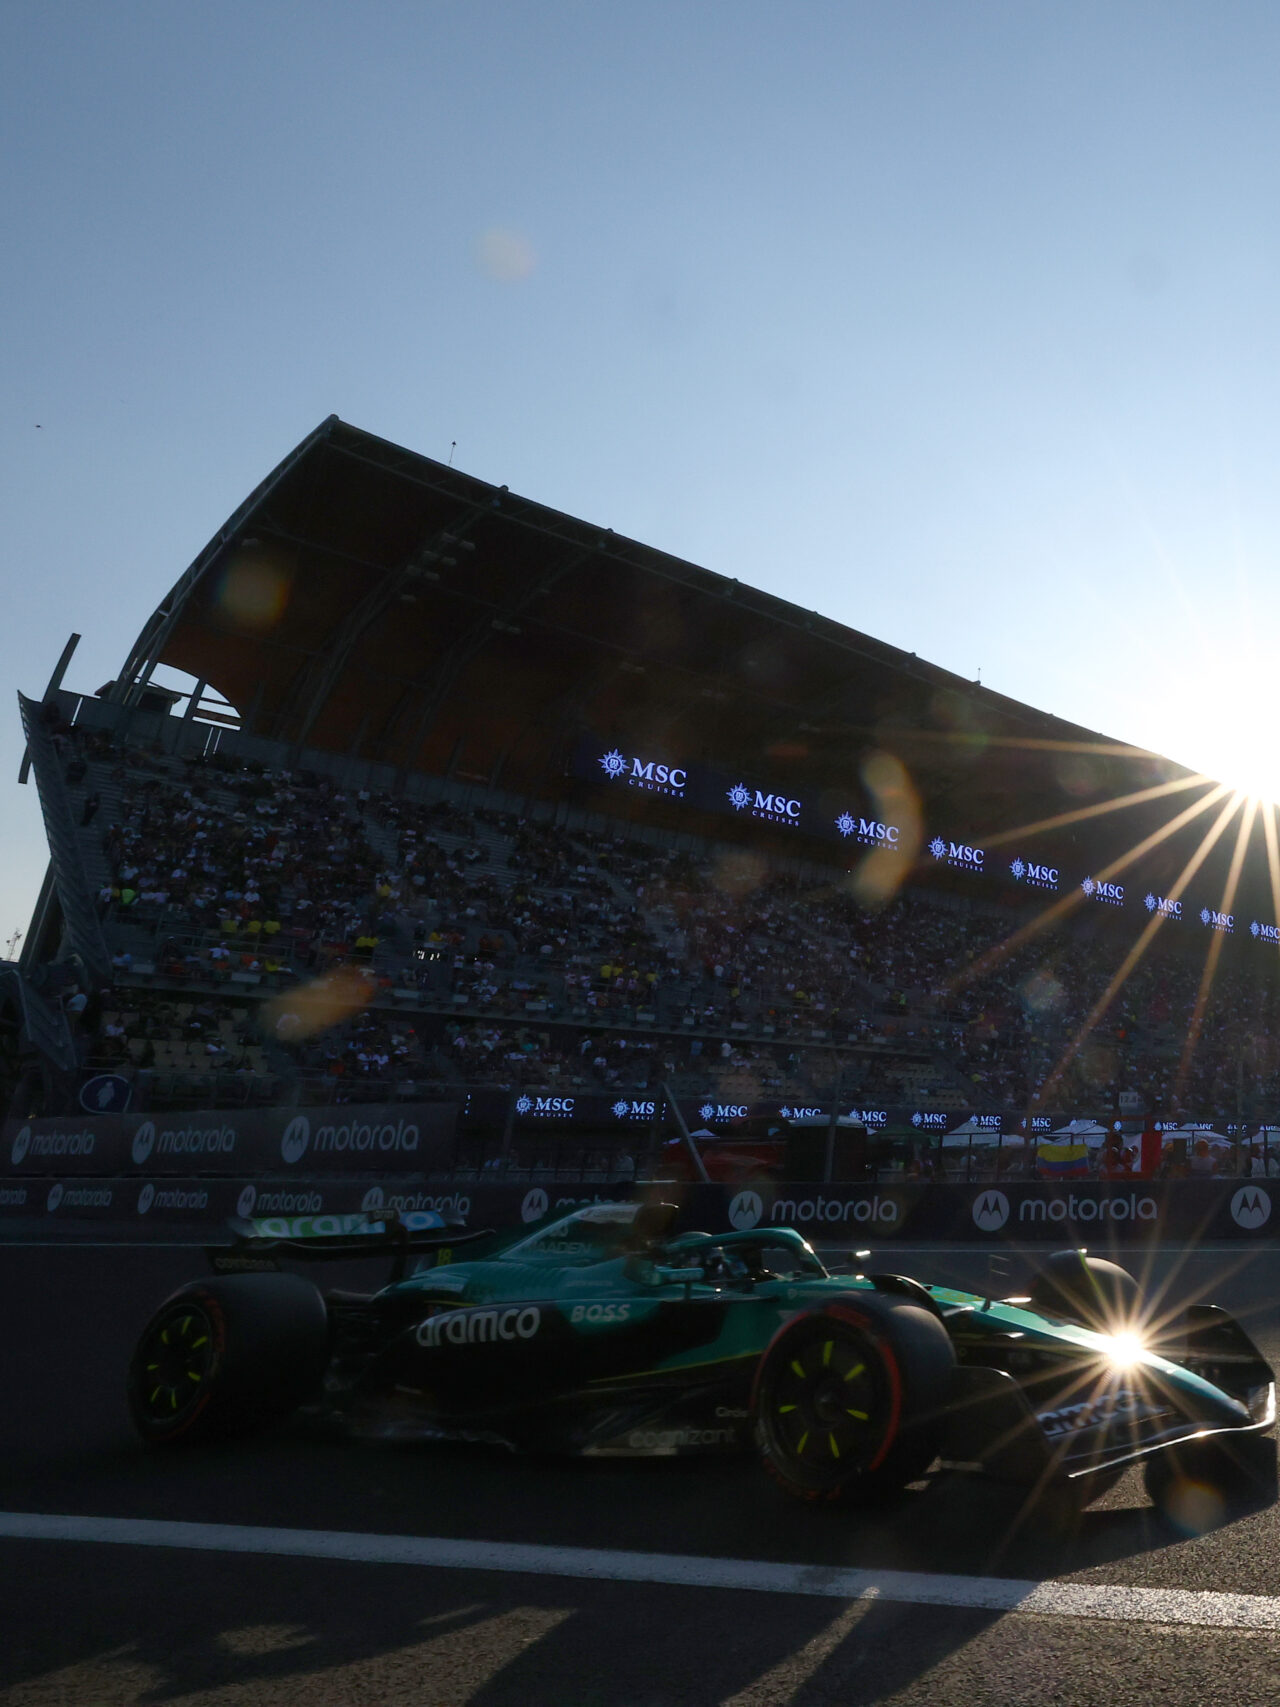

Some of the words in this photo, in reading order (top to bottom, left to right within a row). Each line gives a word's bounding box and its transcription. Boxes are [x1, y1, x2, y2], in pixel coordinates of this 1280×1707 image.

[631, 758, 686, 788] MSC
[629, 779, 684, 798] CRUISES
[754, 791, 801, 817] MSC
[752, 810, 799, 826] CRUISES
[858, 818, 899, 842] MSC
[857, 837, 898, 851] CRUISES
[949, 842, 984, 864] MSC
[948, 859, 983, 872] CRUISES
[1027, 863, 1058, 882] MSC
[1026, 879, 1058, 890] CRUISES
[1097, 881, 1124, 900] MSC
[1158, 897, 1182, 914] MSC
[1212, 911, 1234, 927] MSC
[1260, 924, 1280, 939] MSC
[535, 1097, 574, 1112] MSC
[716, 1104, 748, 1118] MSC
[861, 1110, 887, 1123] MSC
[923, 1113, 947, 1125] MSC
[980, 1115, 1002, 1126] MSC
[1031, 1117, 1052, 1128] MSC
[30, 1129, 96, 1155] motorola
[157, 1124, 236, 1153] motorola
[314, 1119, 419, 1151] motorola
[61, 1188, 112, 1207] motorola
[154, 1189, 208, 1209] motorola
[257, 1190, 322, 1212] motorola
[388, 1192, 470, 1216] motorola
[771, 1195, 897, 1221] motorola
[1019, 1194, 1157, 1221] motorola
[261, 1212, 434, 1238] aramo
[570, 1304, 631, 1323] BOSS
[416, 1306, 541, 1347] aramco
